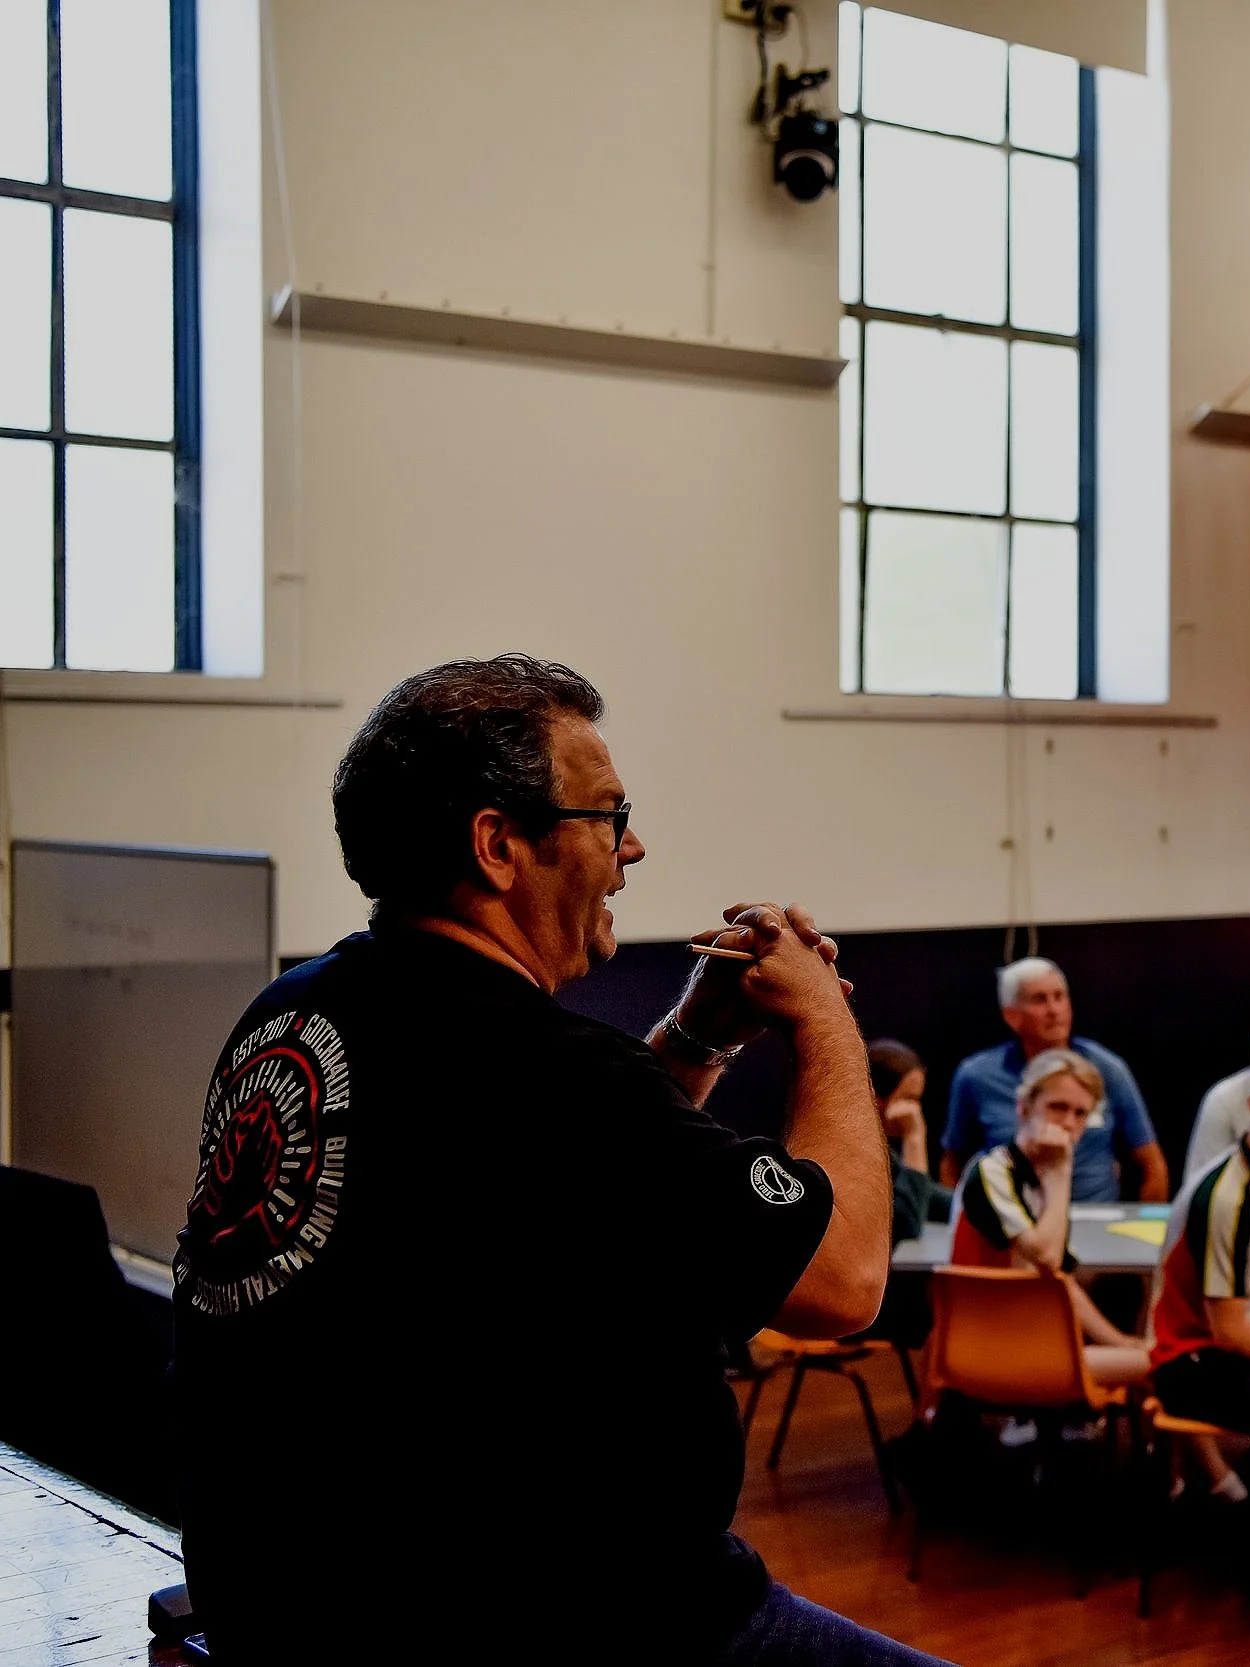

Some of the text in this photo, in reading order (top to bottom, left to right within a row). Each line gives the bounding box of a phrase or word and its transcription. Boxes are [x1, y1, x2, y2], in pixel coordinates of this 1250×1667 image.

[259, 1010, 298, 1048] 2017
[299, 1013, 350, 1114] GOTCHA4LIFE
[299, 1136, 347, 1248] BUILDING
[242, 1241, 314, 1306] MENTAL
